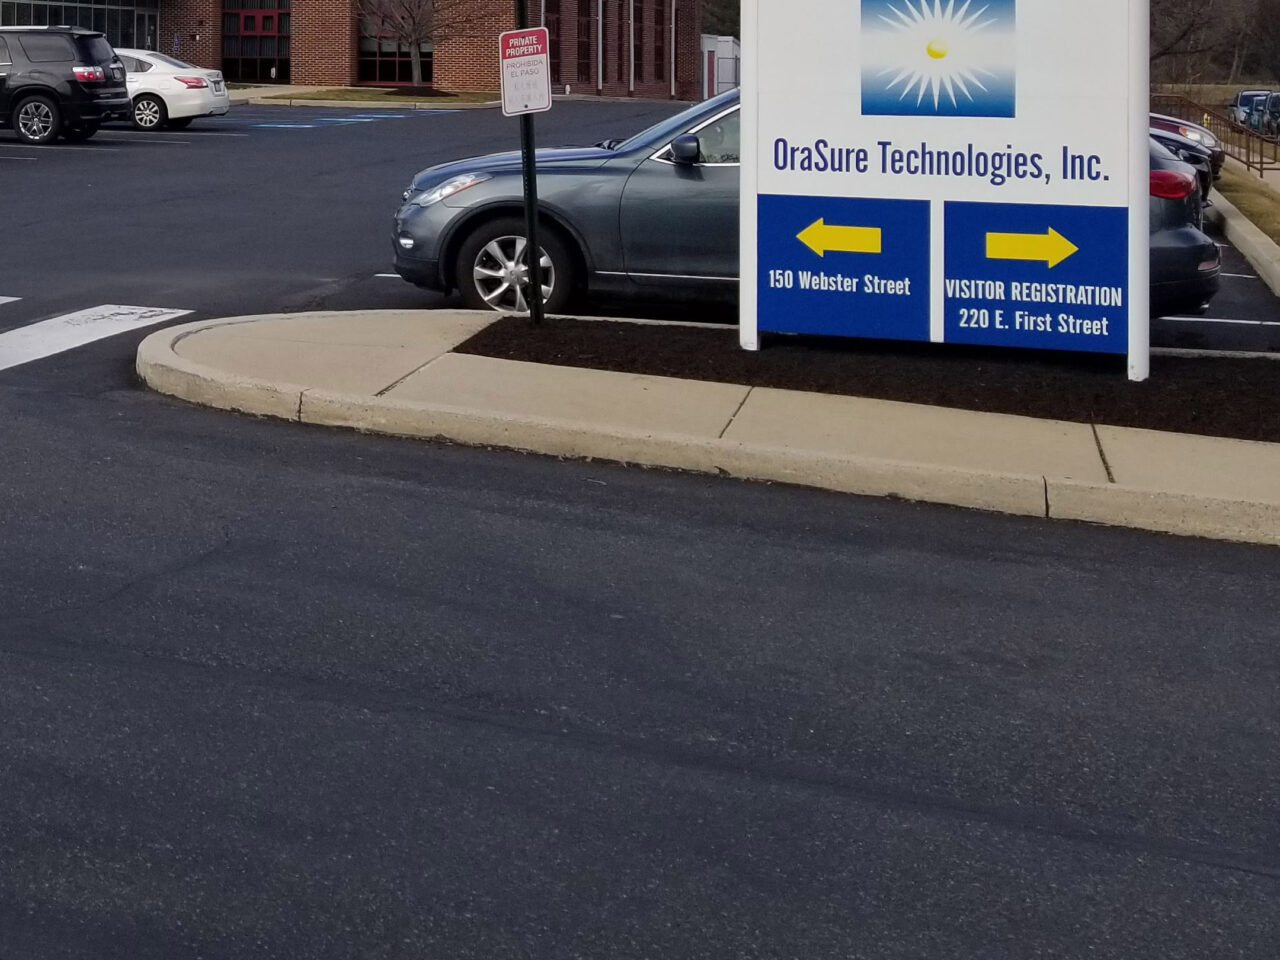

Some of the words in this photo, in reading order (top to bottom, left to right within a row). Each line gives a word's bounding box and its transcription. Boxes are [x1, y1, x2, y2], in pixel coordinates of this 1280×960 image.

[505, 45, 542, 57] PROPERTY
[509, 35, 538, 47] PRIVATE
[773, 137, 869, 173] OraSure
[877, 140, 1051, 186] Technologies,
[1062, 145, 1110, 181] Inc.
[769, 269, 793, 289] 150
[798, 270, 859, 293] Webster
[864, 274, 911, 296] Street
[945, 279, 1005, 300] VISITOR
[1011, 281, 1122, 307] REGISTRATION
[959, 308, 989, 328] 220
[995, 310, 1009, 329] E.
[1015, 311, 1052, 332] First
[1058, 313, 1109, 336] Street
